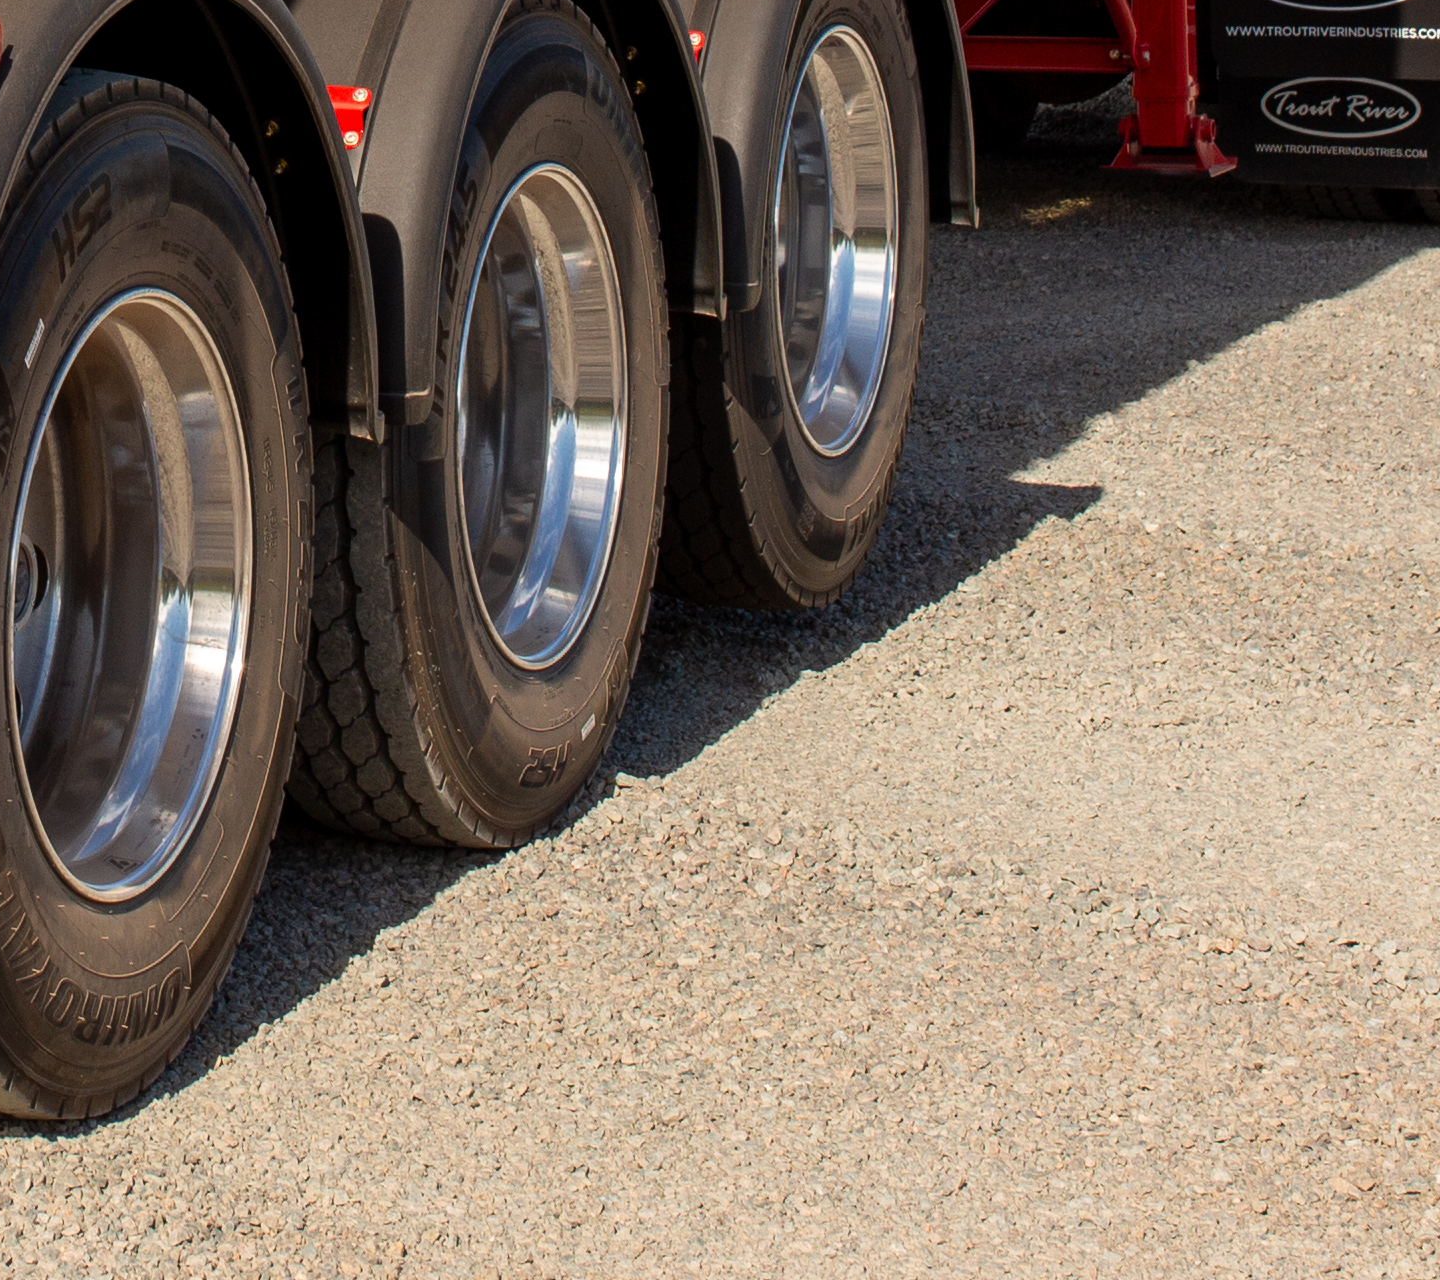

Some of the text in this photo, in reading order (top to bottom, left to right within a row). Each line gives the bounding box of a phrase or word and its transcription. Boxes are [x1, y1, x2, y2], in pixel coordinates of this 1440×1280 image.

[1274, 91, 1409, 122] Trout River
[1255, 143, 1428, 158] WWW.TROUTRIVERINDUSTRIES.COM
